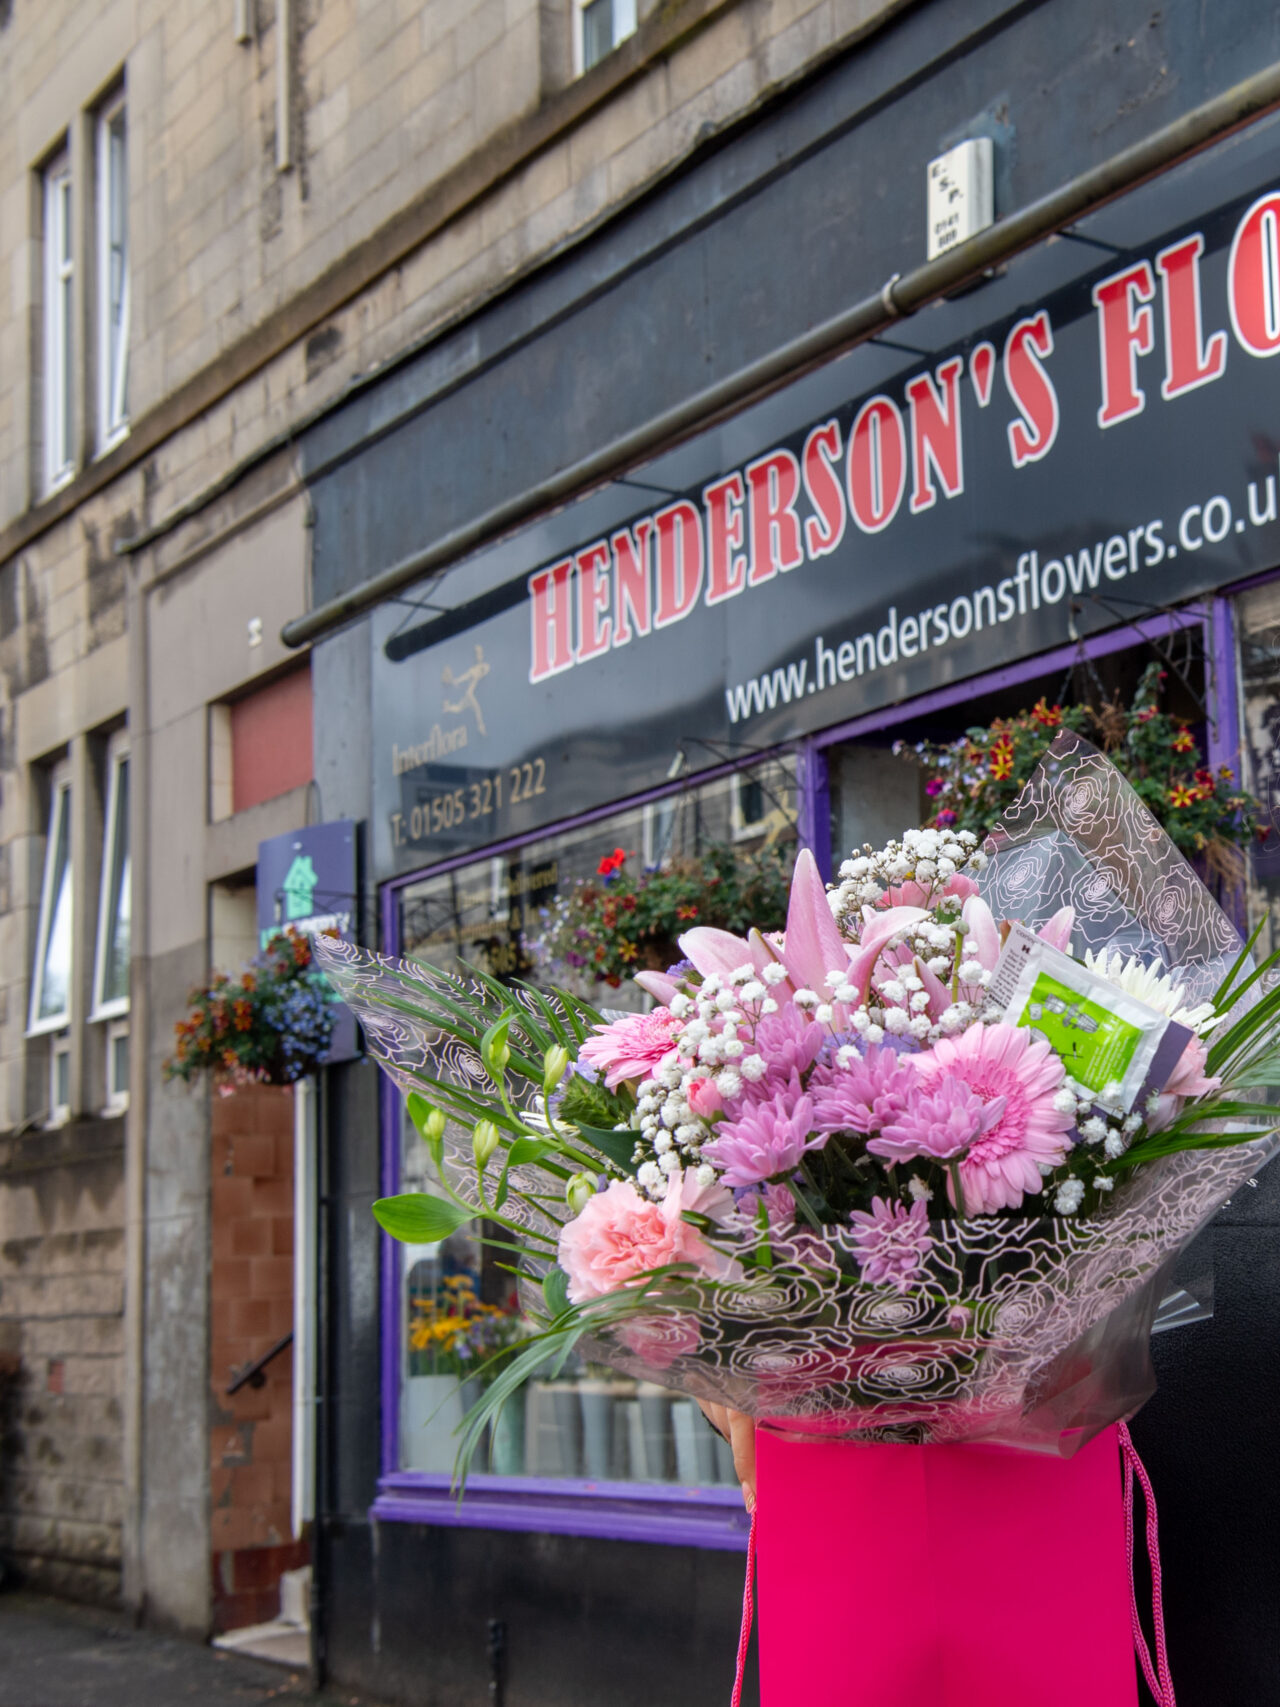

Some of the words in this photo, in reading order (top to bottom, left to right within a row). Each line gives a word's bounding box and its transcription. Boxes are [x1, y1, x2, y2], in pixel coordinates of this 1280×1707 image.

[528, 309, 1060, 685] HENDERSON'S
[392, 723, 468, 777] Interflora
[392, 812, 407, 848] T:
[410, 788, 465, 841] 01505
[470, 774, 503, 820] 321
[509, 756, 547, 804] 222
